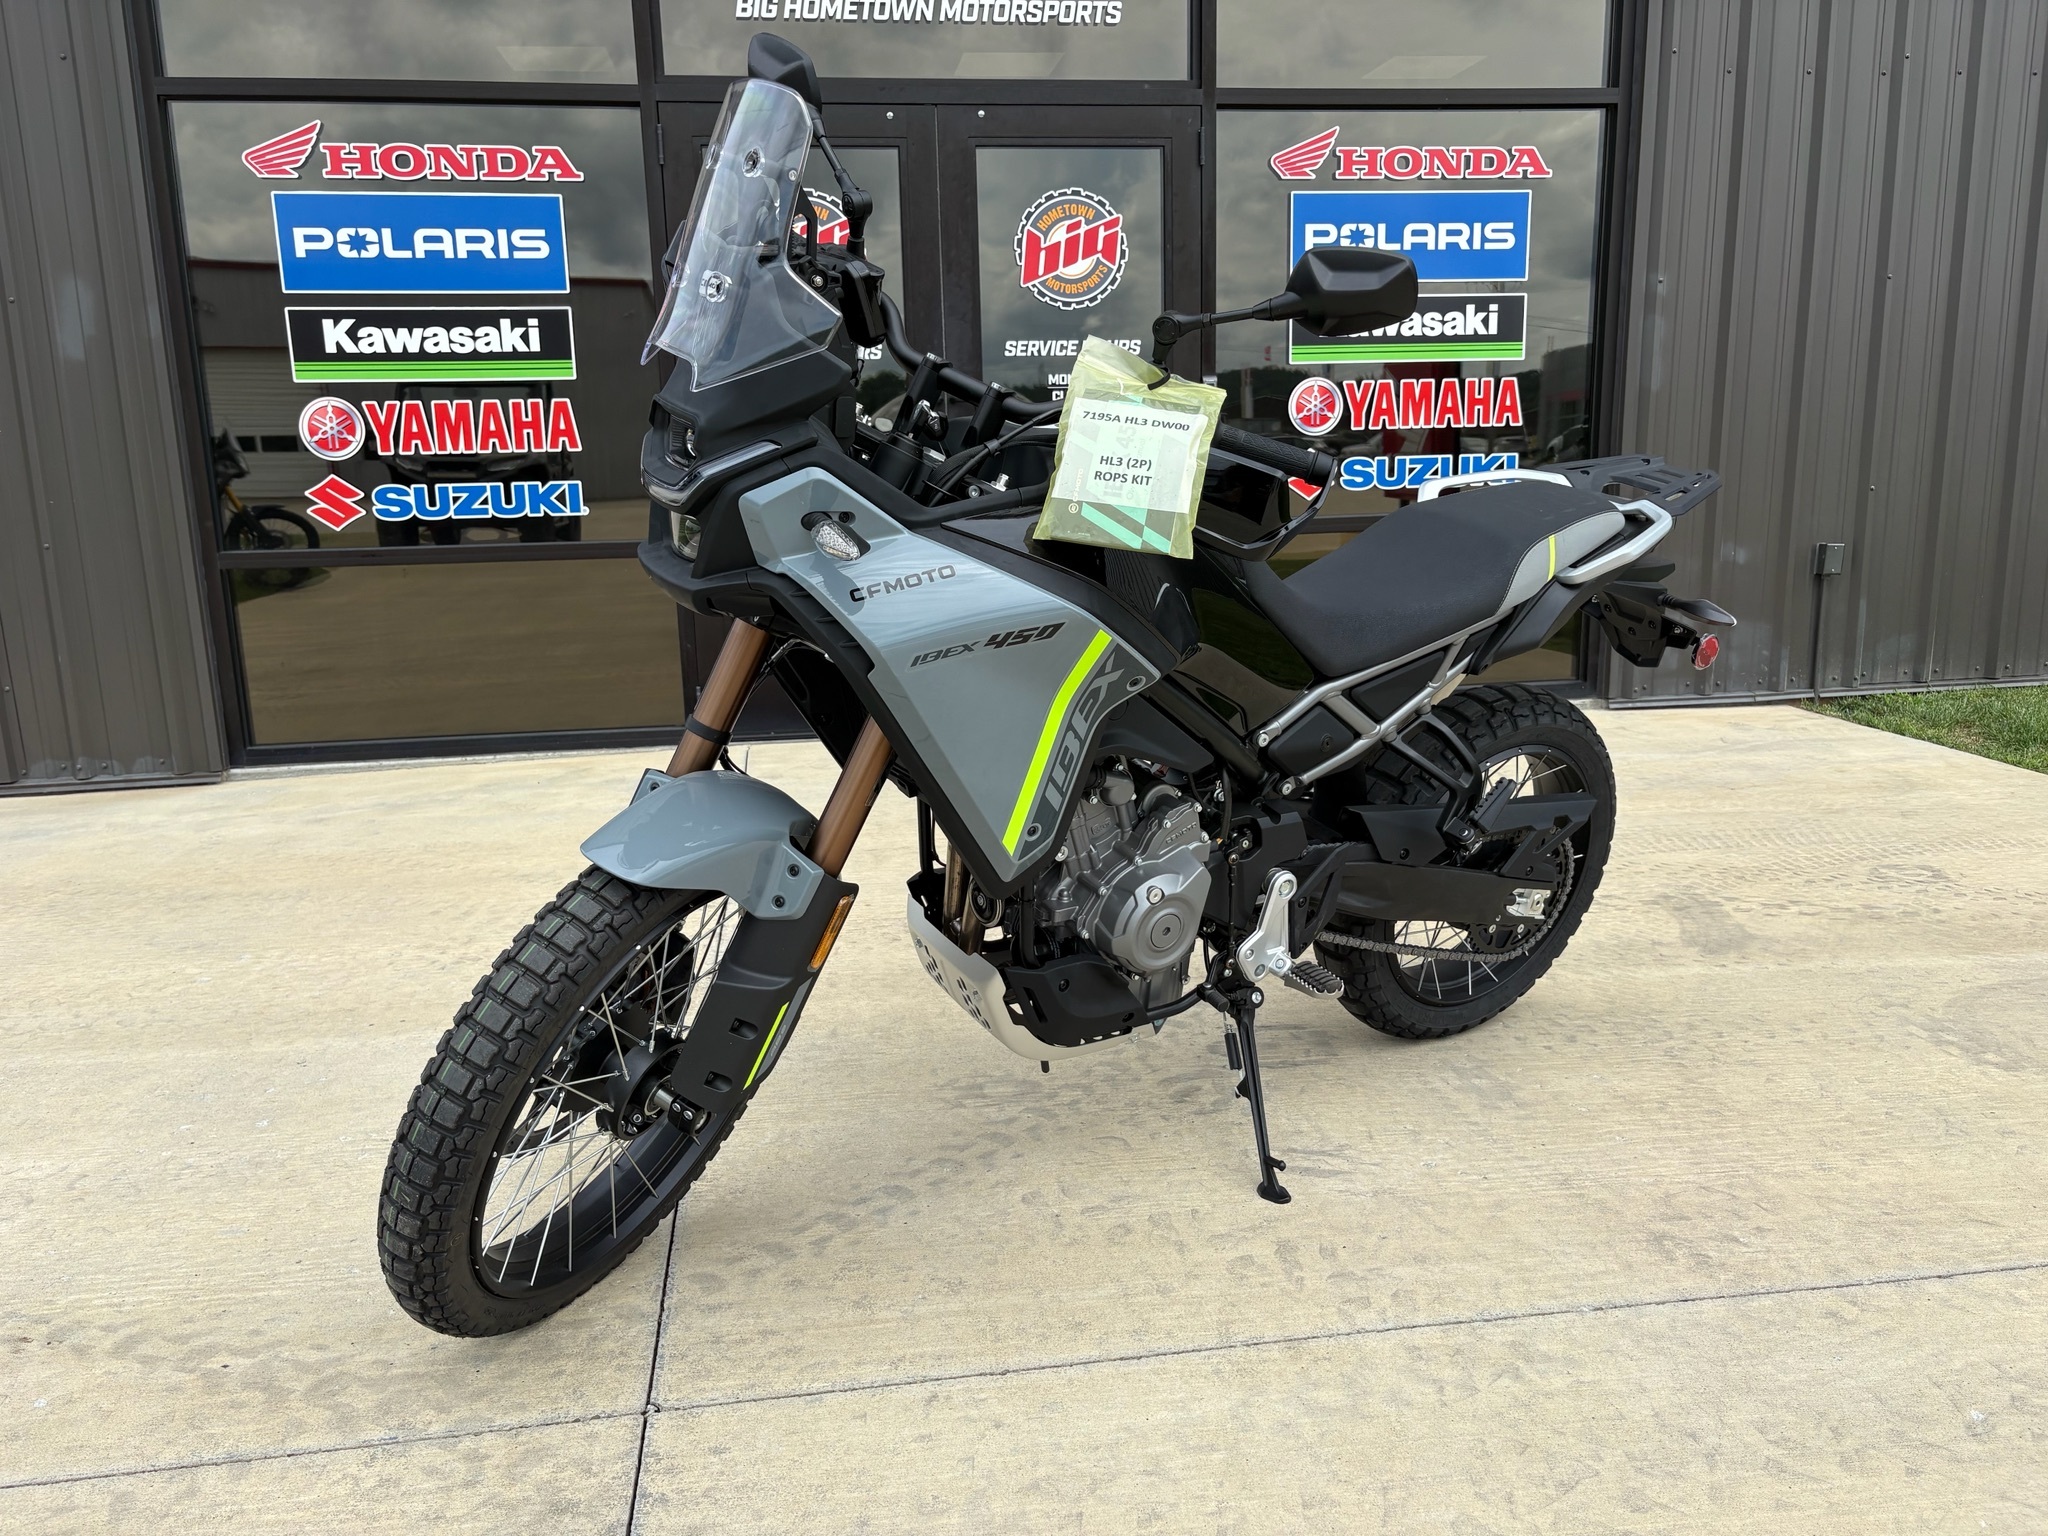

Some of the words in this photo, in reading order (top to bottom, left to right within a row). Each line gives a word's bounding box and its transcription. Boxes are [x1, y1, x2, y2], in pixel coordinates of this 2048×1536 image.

[736, 0, 778, 19] BIG
[784, 0, 934, 22] HOMETOWN
[939, 0, 1122, 24] MOTORSPORTS
[322, 143, 585, 181] HONDA
[1335, 146, 1553, 179] HONDA
[1037, 204, 1096, 231] HOMETOWN
[292, 227, 550, 260] POLARIS
[1304, 222, 1516, 251] POLARIS
[1045, 264, 1108, 294] MOTORSPORTS
[322, 318, 541, 354] Kawasaki
[1004, 339, 1079, 357] SERVICE
[1344, 377, 1523, 430] YAMAHA
[362, 398, 583, 455] YAMAHA
[1082, 411, 1121, 423] 7195A
[1125, 416, 1148, 426] HL3
[1151, 419, 1190, 431] DW00
[1094, 470, 1128, 484] ROPS
[1131, 474, 1153, 486] KIT
[1099, 455, 1123, 468] HL3
[1126, 457, 1152, 472] (2P)
[371, 481, 588, 521] SUZUKI
[1072, 468, 1084, 502] CFMOTO
[849, 565, 957, 602] CFMOTO
[909, 640, 981, 668] IBEX
[983, 621, 1066, 650] 450
[1044, 651, 1125, 812] IBEX
